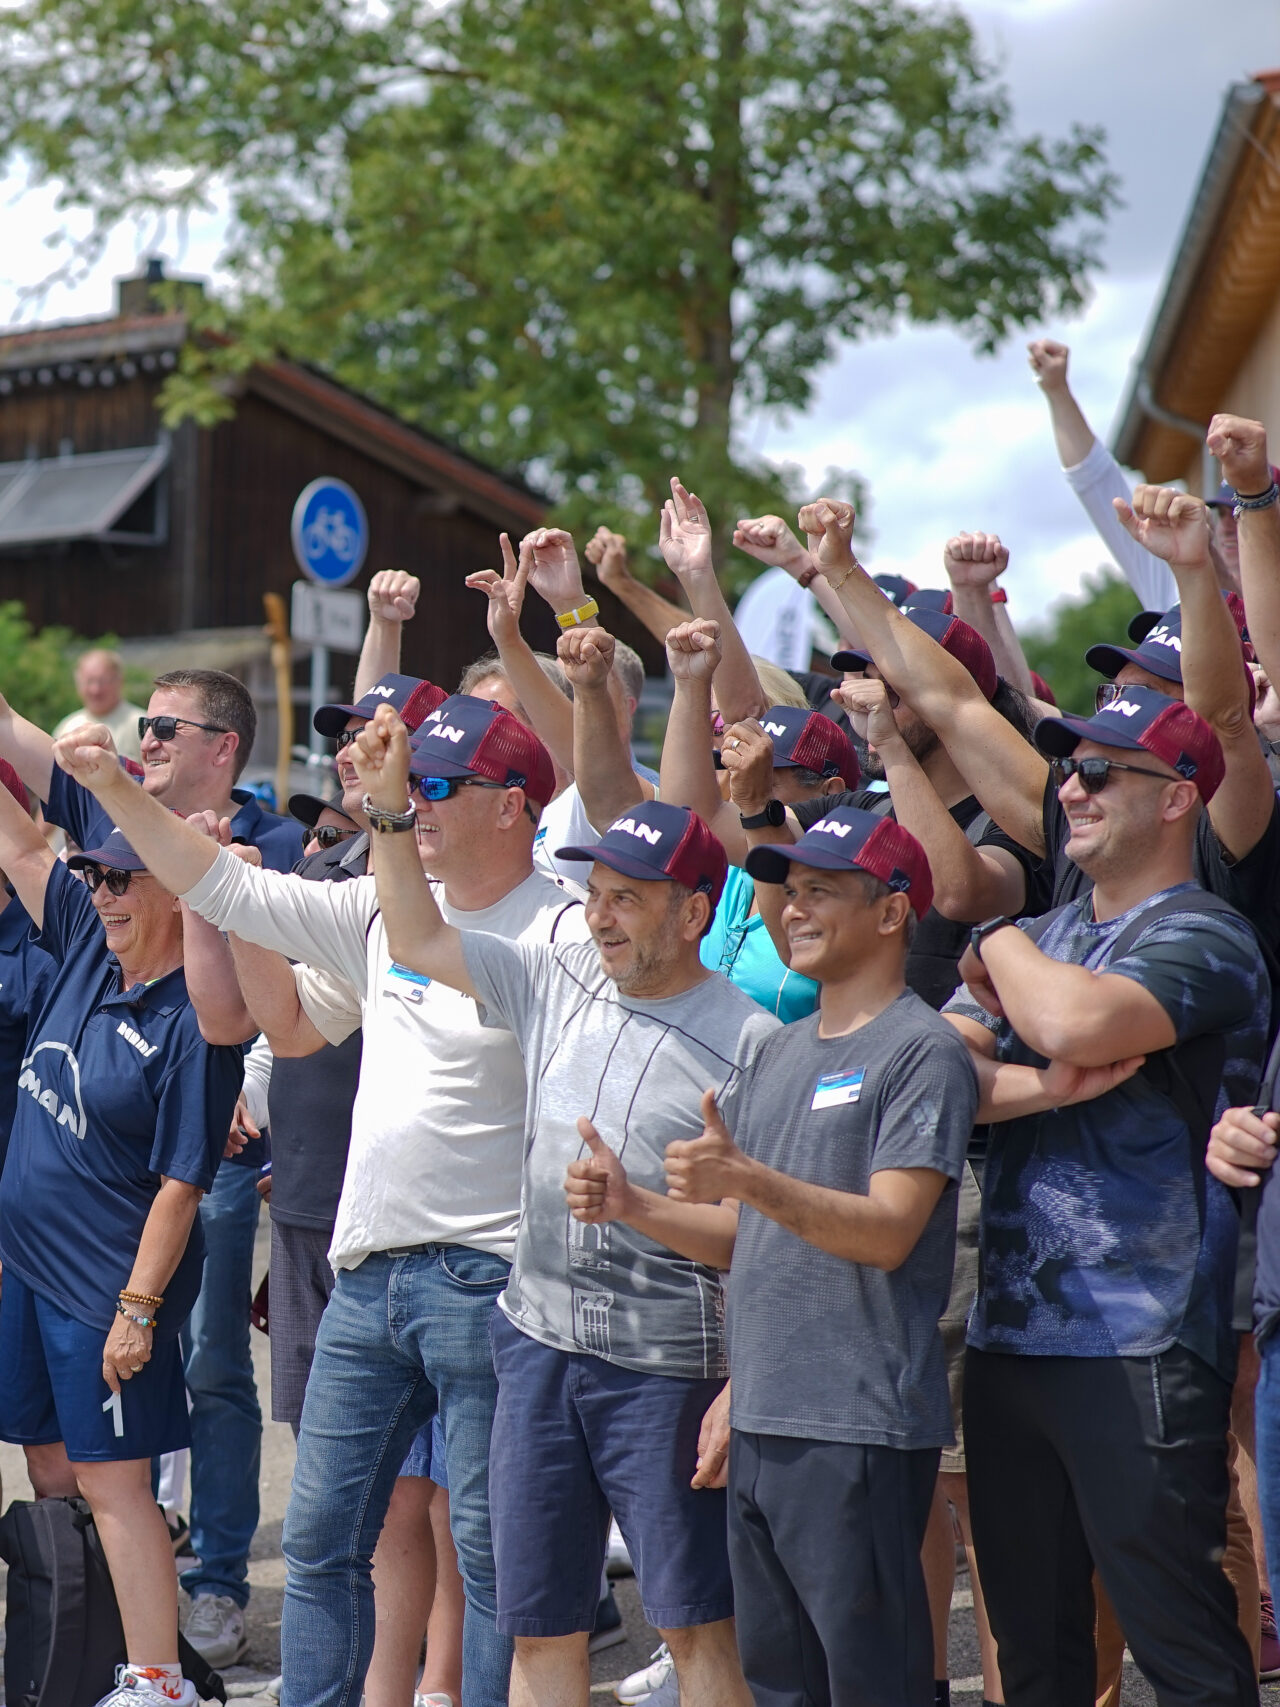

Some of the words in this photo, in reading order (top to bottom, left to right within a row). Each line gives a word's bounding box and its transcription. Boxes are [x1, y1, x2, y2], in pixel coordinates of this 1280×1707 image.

[1147, 633, 1182, 652] AN
[1099, 699, 1142, 717] AN
[427, 723, 466, 743] AN
[806, 819, 852, 838] AN
[18, 1068, 78, 1135] MAN
[102, 1391, 124, 1437] 1
